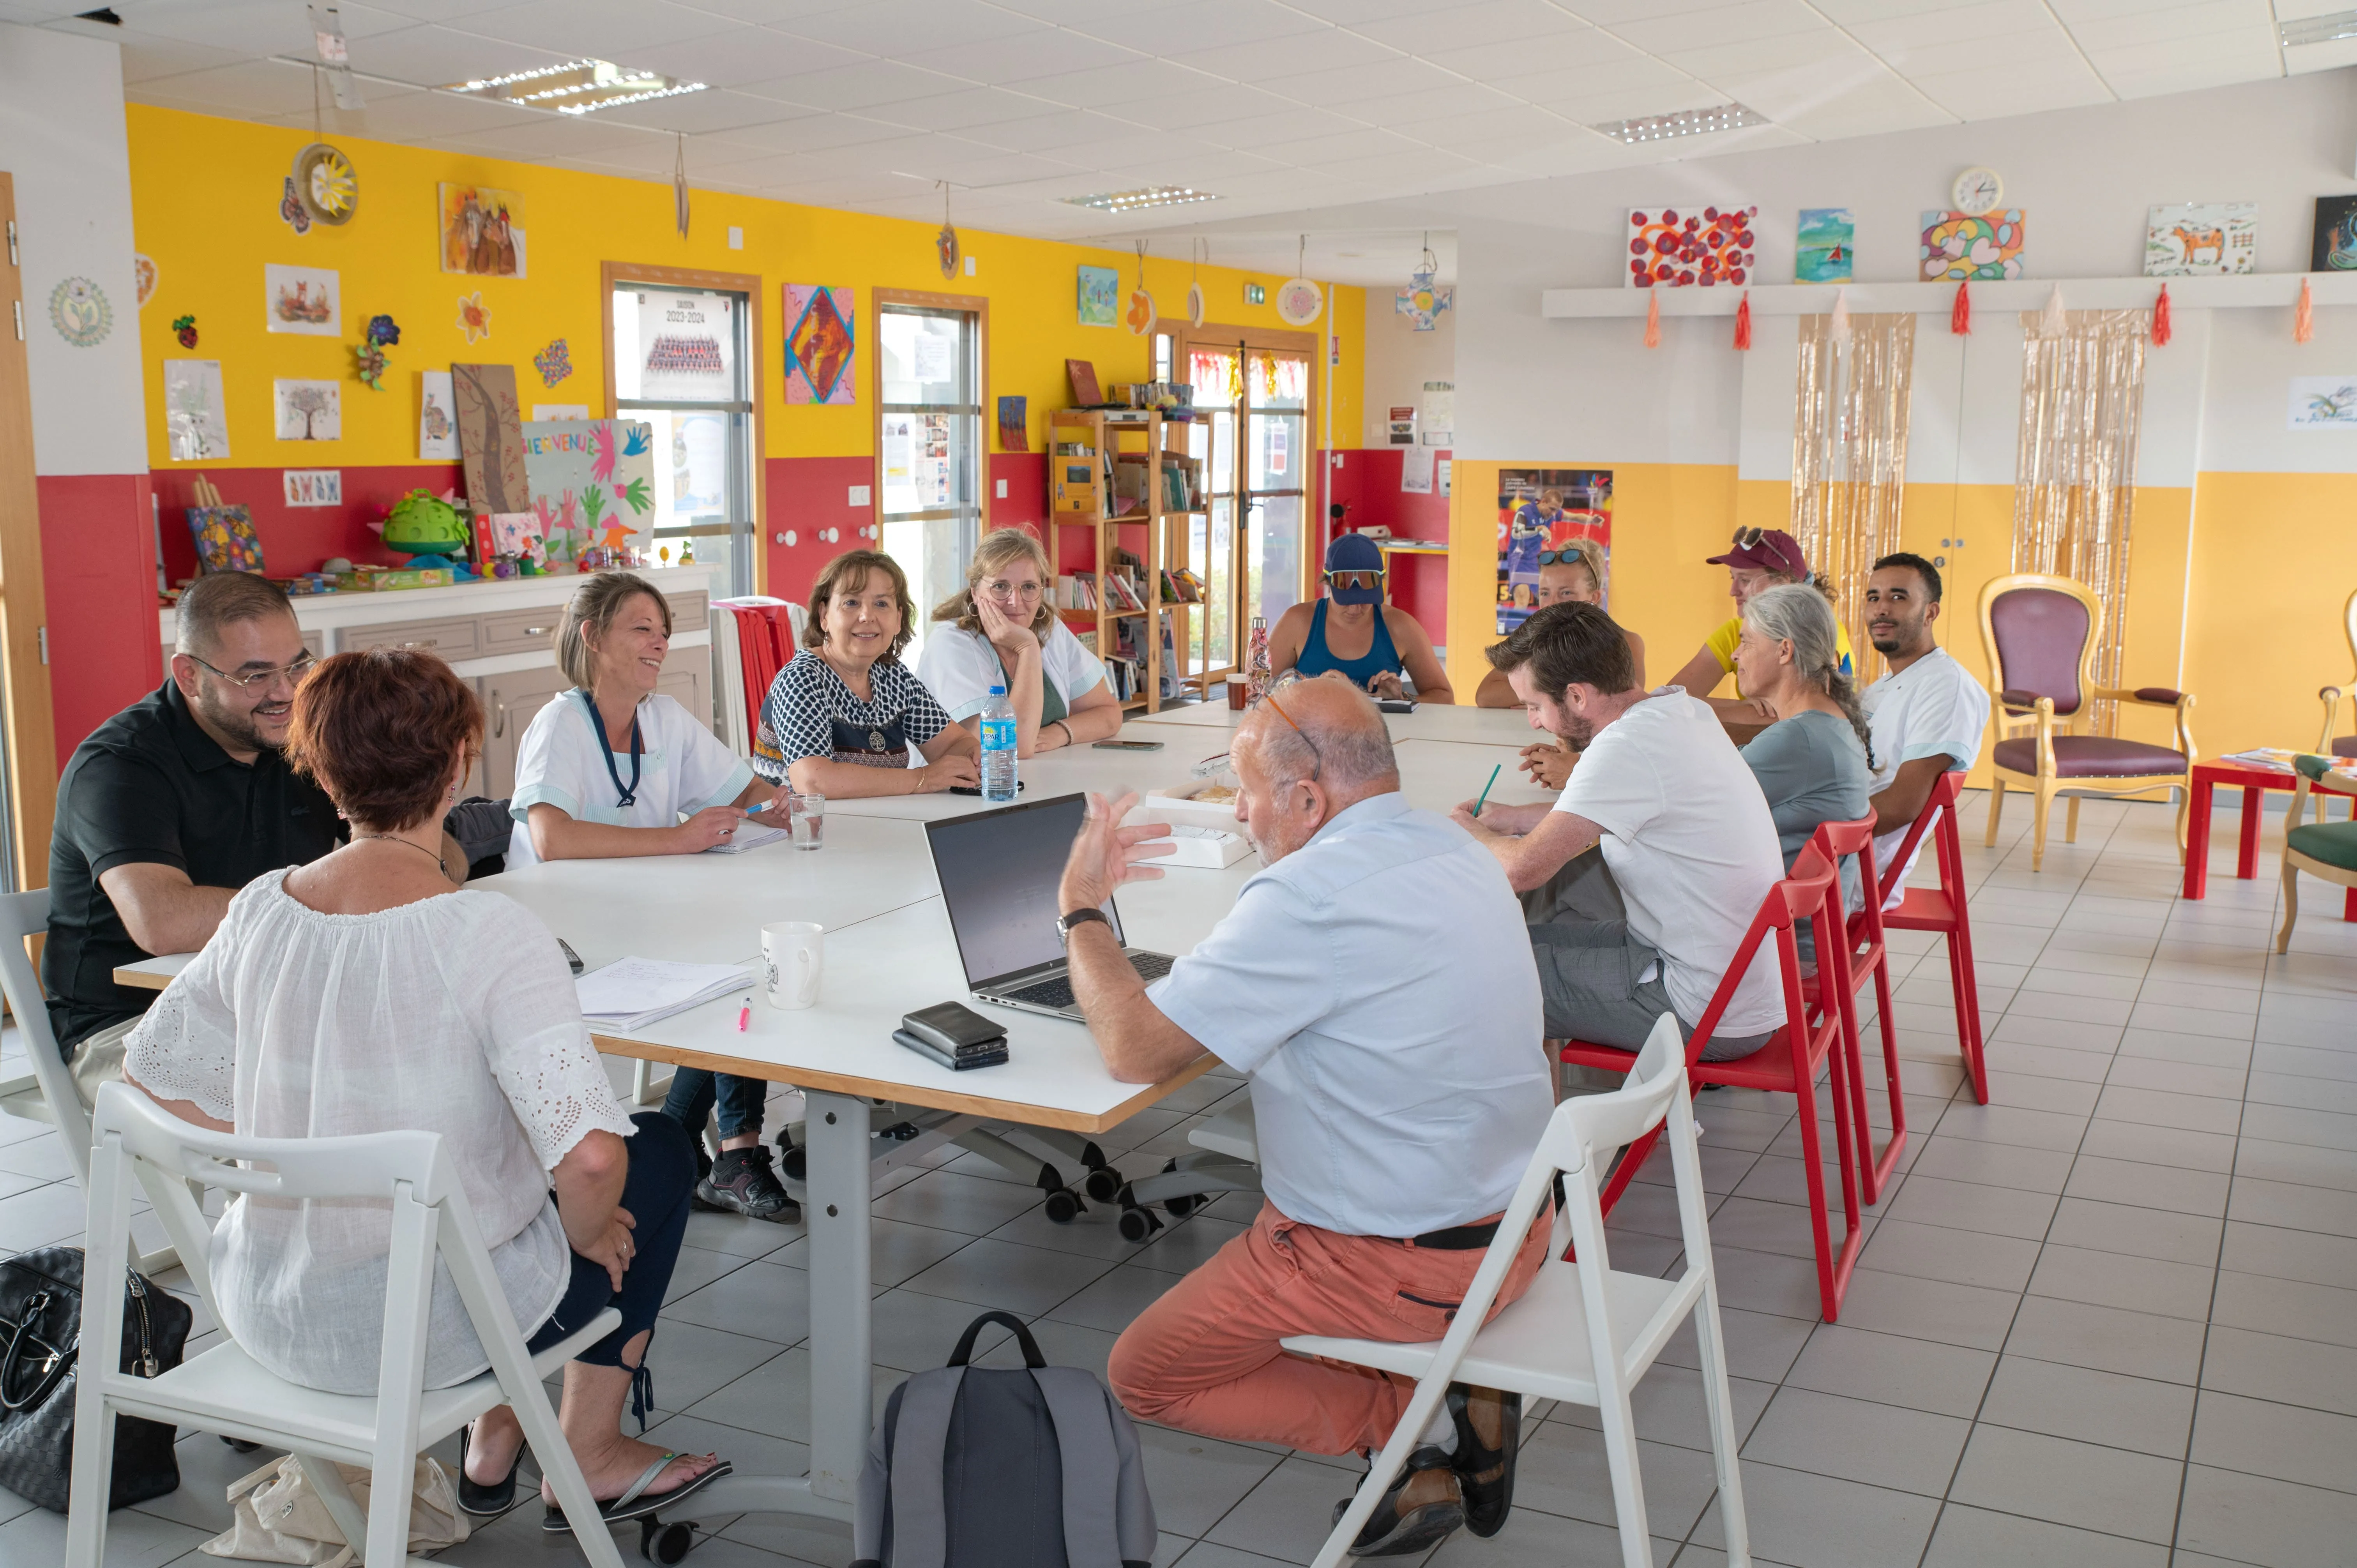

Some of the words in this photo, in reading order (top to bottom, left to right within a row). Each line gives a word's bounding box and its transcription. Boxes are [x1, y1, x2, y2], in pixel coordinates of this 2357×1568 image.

[676, 300, 695, 309] SAISON
[666, 310, 705, 323] 2023-2024
[1500, 585, 1509, 600] 5
